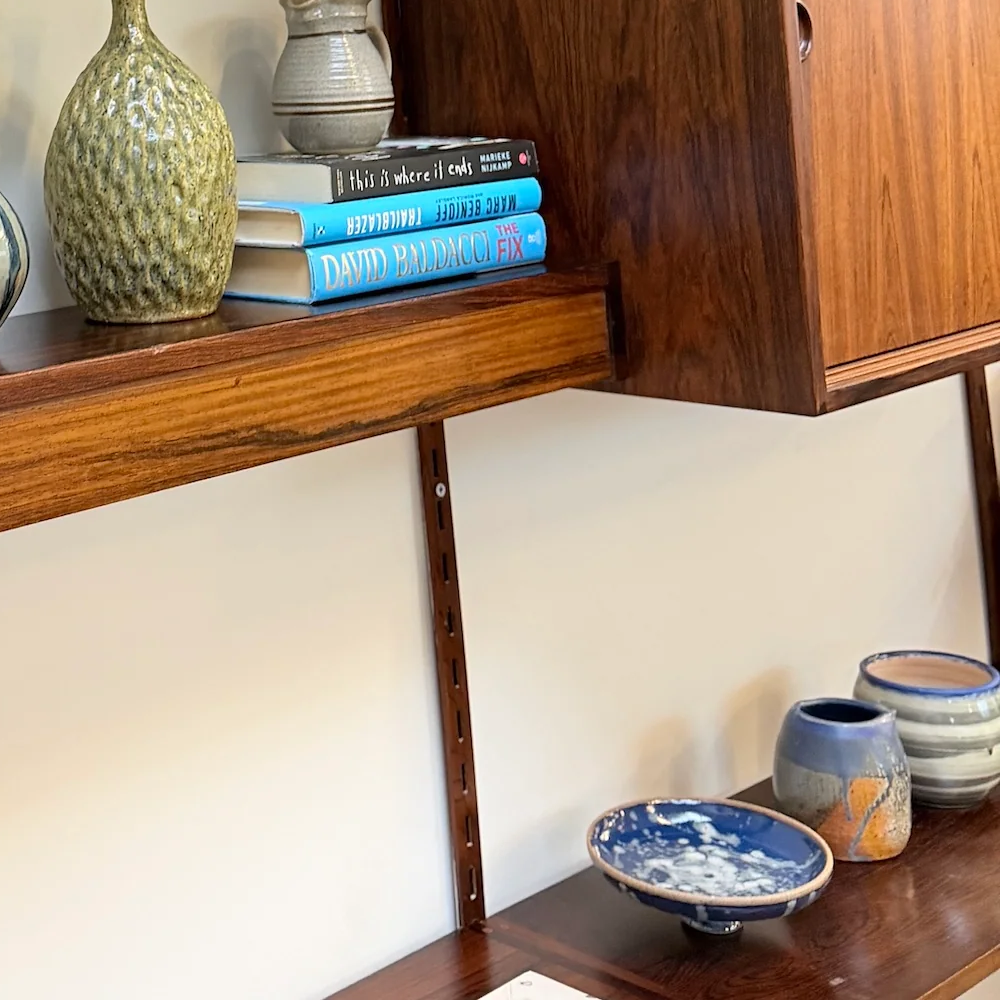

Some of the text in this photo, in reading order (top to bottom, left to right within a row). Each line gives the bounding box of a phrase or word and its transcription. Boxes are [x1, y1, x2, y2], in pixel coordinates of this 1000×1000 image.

[480, 151, 511, 163] MARIEKE
[481, 161, 512, 173] NIJKAMP
[349, 169, 374, 191] this
[380, 168, 389, 188] is
[394, 165, 430, 186] where
[433, 159, 443, 180] it
[448, 156, 473, 176] ends
[346, 194, 517, 236] MARC BENIOFF TRAILBLAZER
[495, 222, 519, 236] THE
[321, 230, 490, 291] DAVID BALDACCI
[497, 236, 524, 263] FIX
